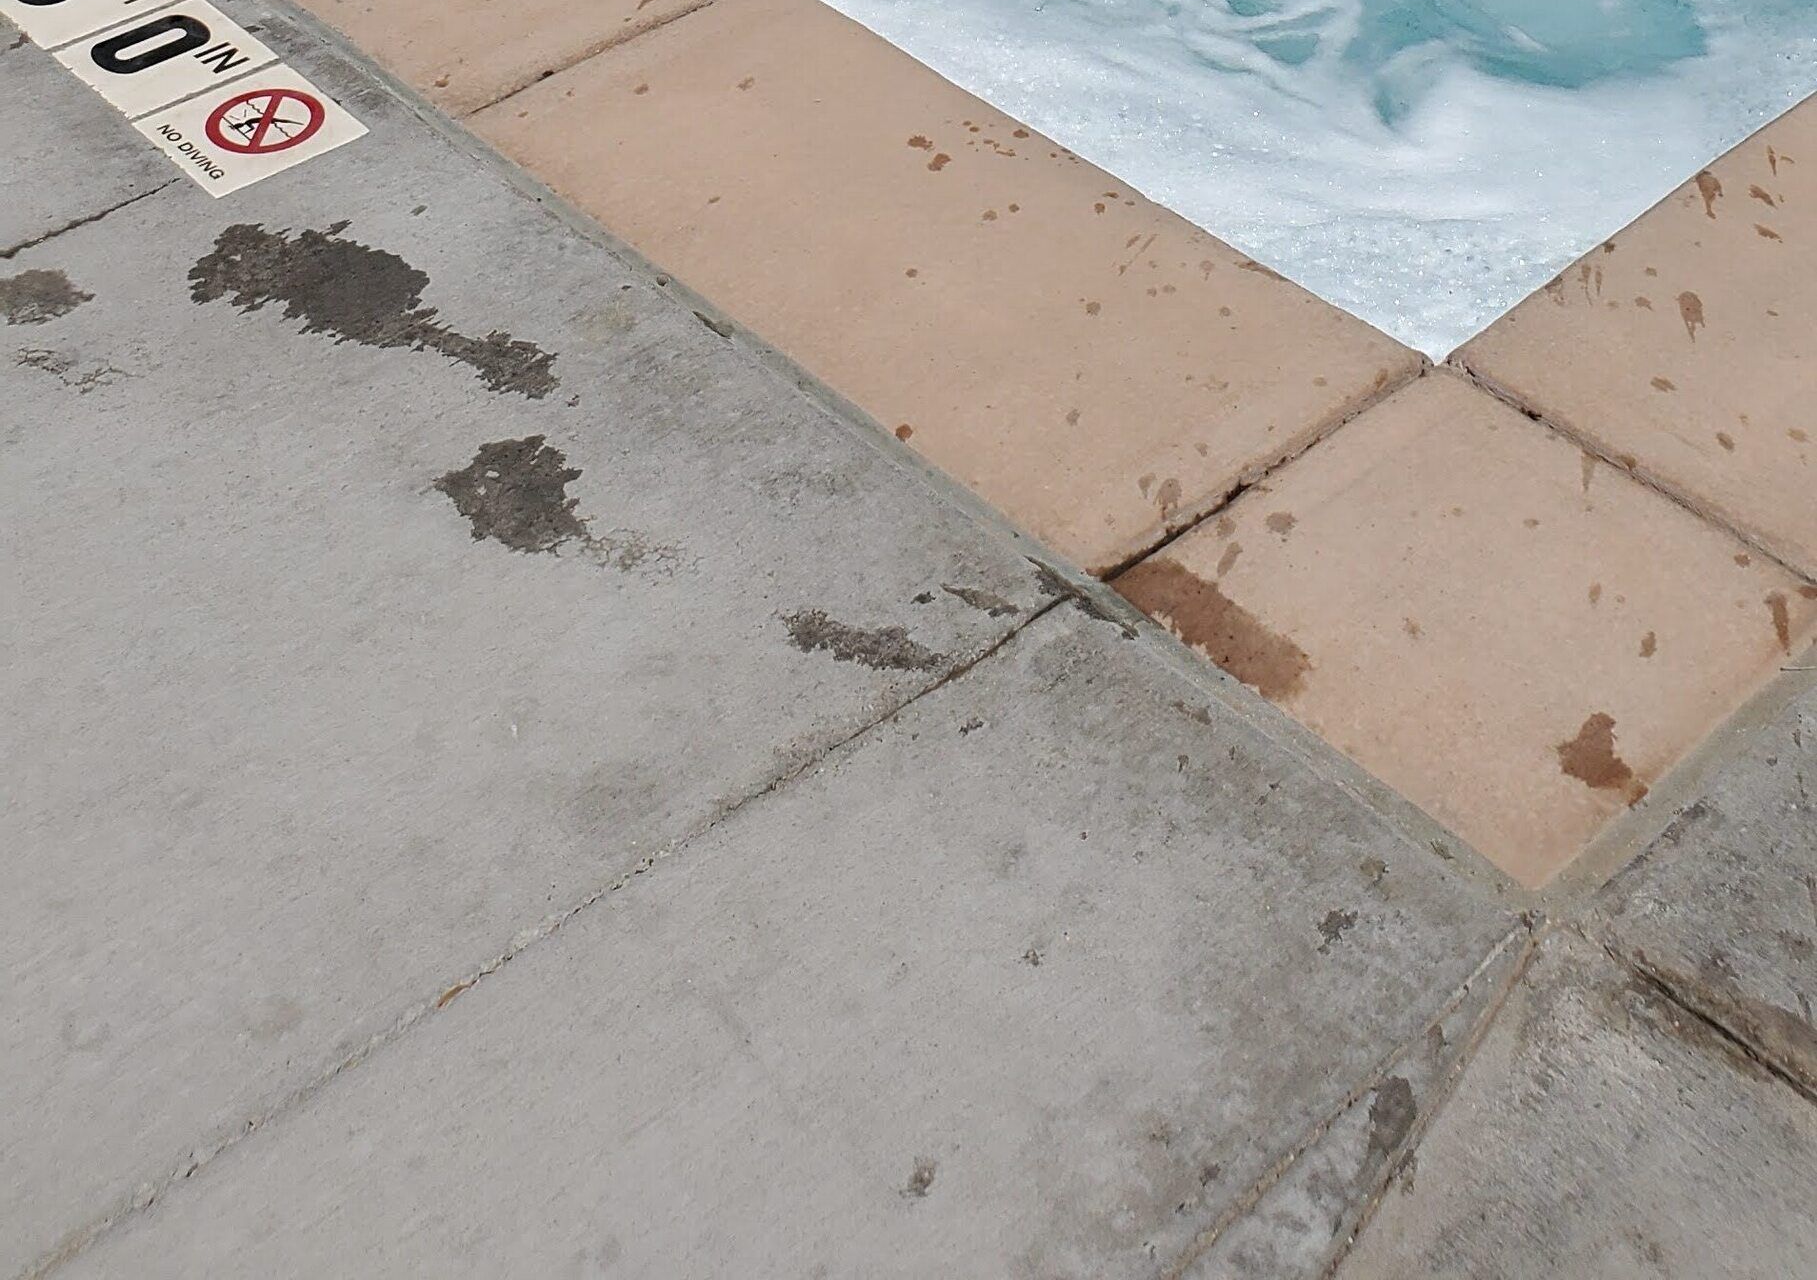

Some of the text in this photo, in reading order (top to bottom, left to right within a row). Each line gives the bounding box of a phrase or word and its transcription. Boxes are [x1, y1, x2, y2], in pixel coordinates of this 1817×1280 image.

[90, 14, 211, 74] 0
[194, 42, 250, 75] IN
[157, 123, 225, 181] NO DIVING
